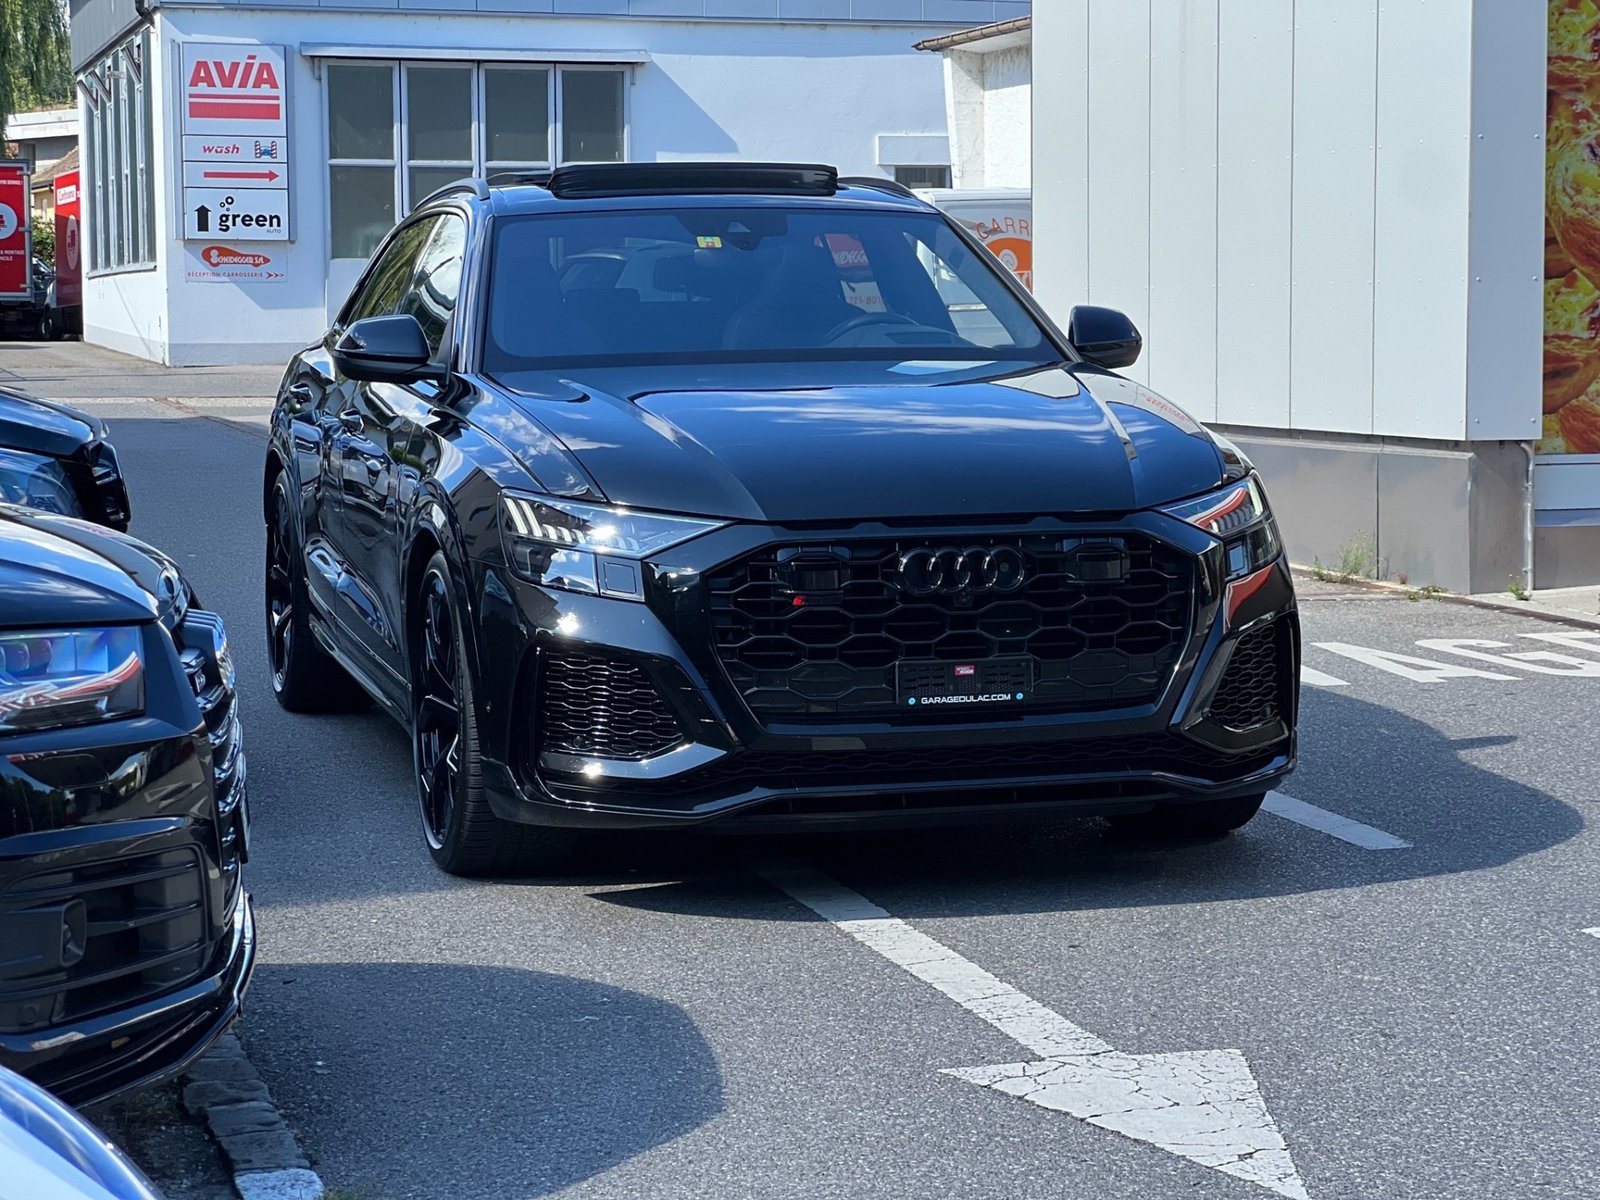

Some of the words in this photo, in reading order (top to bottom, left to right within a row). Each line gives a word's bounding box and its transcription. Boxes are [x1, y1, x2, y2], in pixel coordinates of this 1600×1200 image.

[202, 144, 240, 154] wash
[218, 213, 281, 232] green
[921, 693, 1011, 705] GARAGEDULAC.COM
